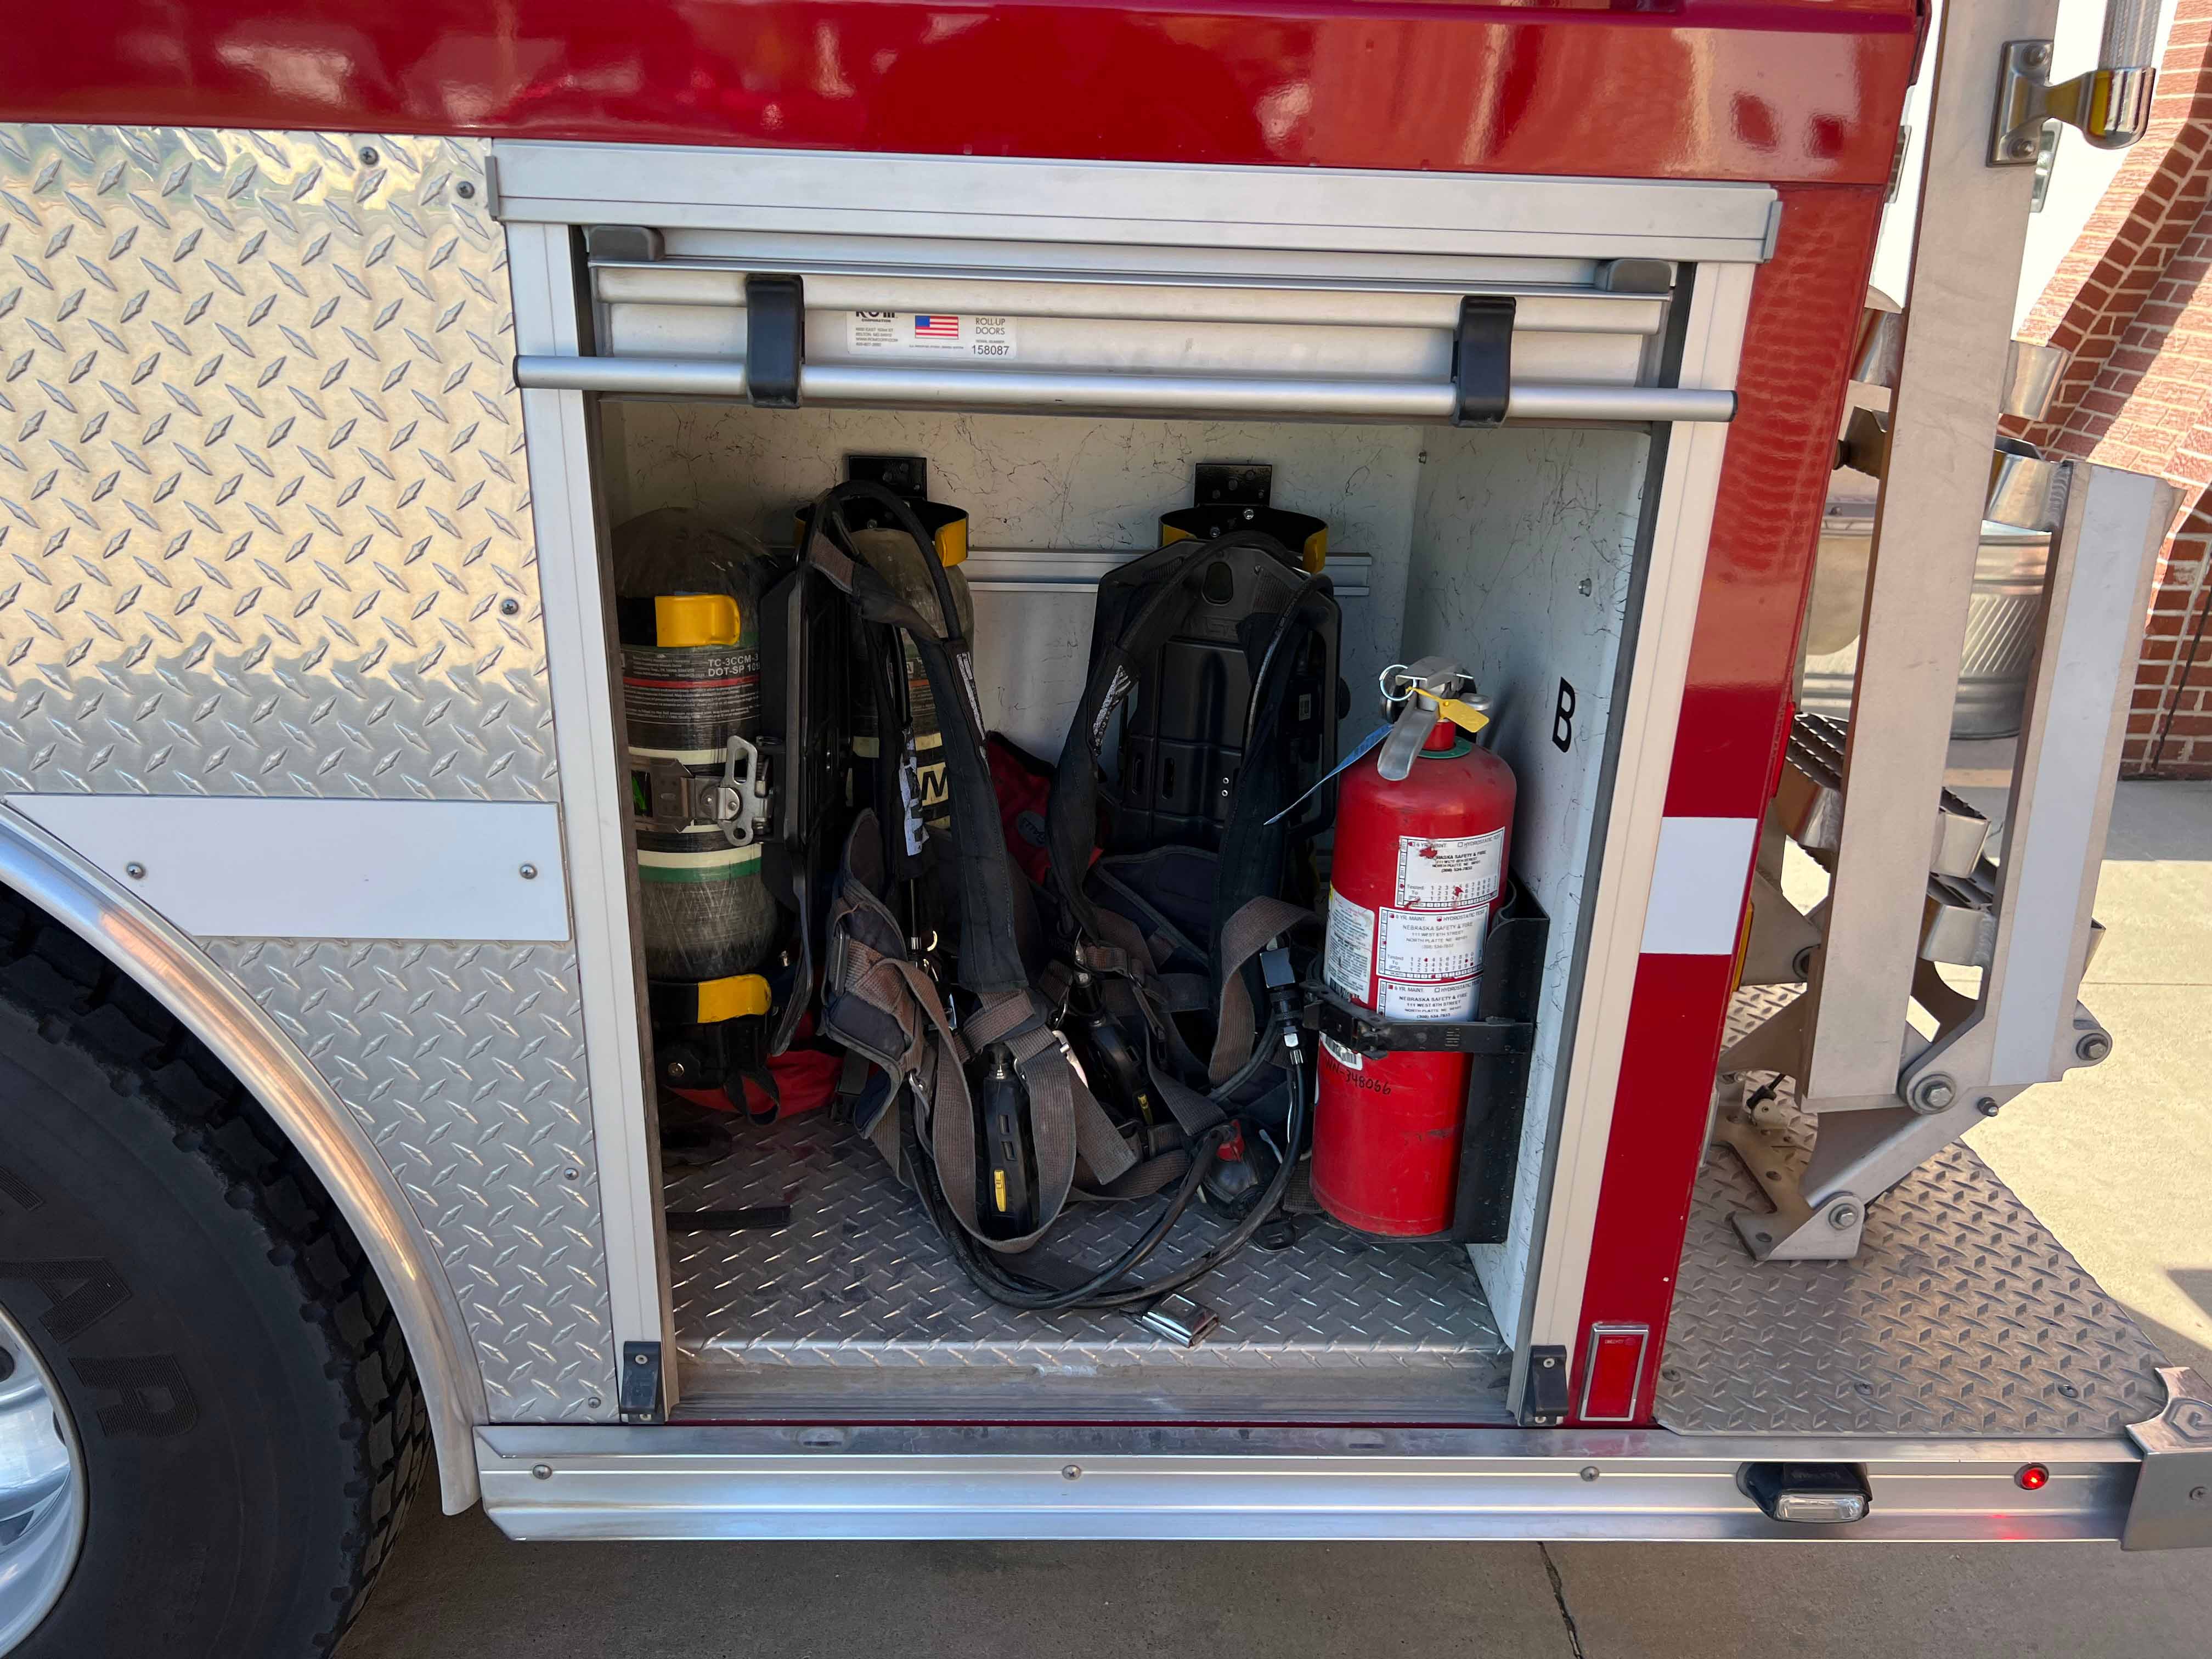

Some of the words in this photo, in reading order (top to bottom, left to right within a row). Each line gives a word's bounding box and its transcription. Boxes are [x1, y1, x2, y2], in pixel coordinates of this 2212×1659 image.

[972, 345, 1009, 355] 158087
[708, 665, 744, 676] DOT-SP
[1552, 676, 1575, 753] B
[1443, 912, 1475, 921] HYDROSTATIC
[1441, 983, 1471, 992] HYDROSTATIC
